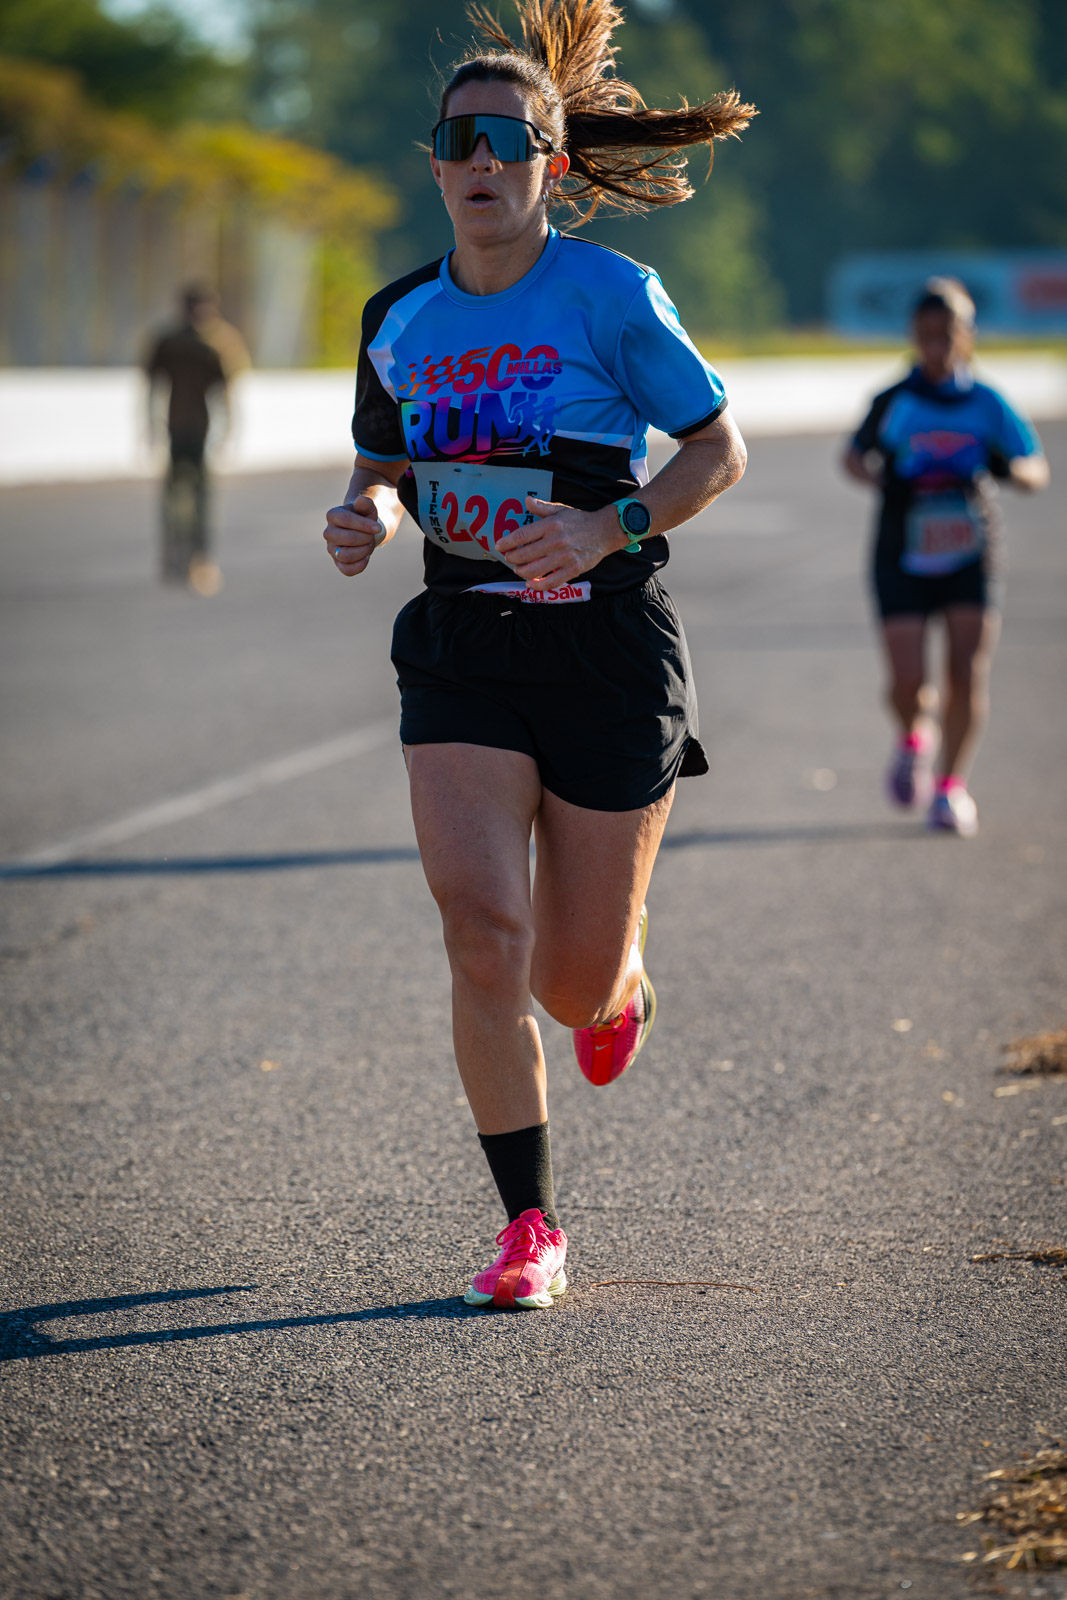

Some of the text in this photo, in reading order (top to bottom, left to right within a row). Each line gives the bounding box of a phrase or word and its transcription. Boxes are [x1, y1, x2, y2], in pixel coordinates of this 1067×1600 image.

[452, 343, 559, 394] 500
[506, 361, 563, 376] MILLAS
[401, 391, 529, 460] RUN
[428, 480, 450, 544] TIEMPO
[441, 491, 524, 557] 226
